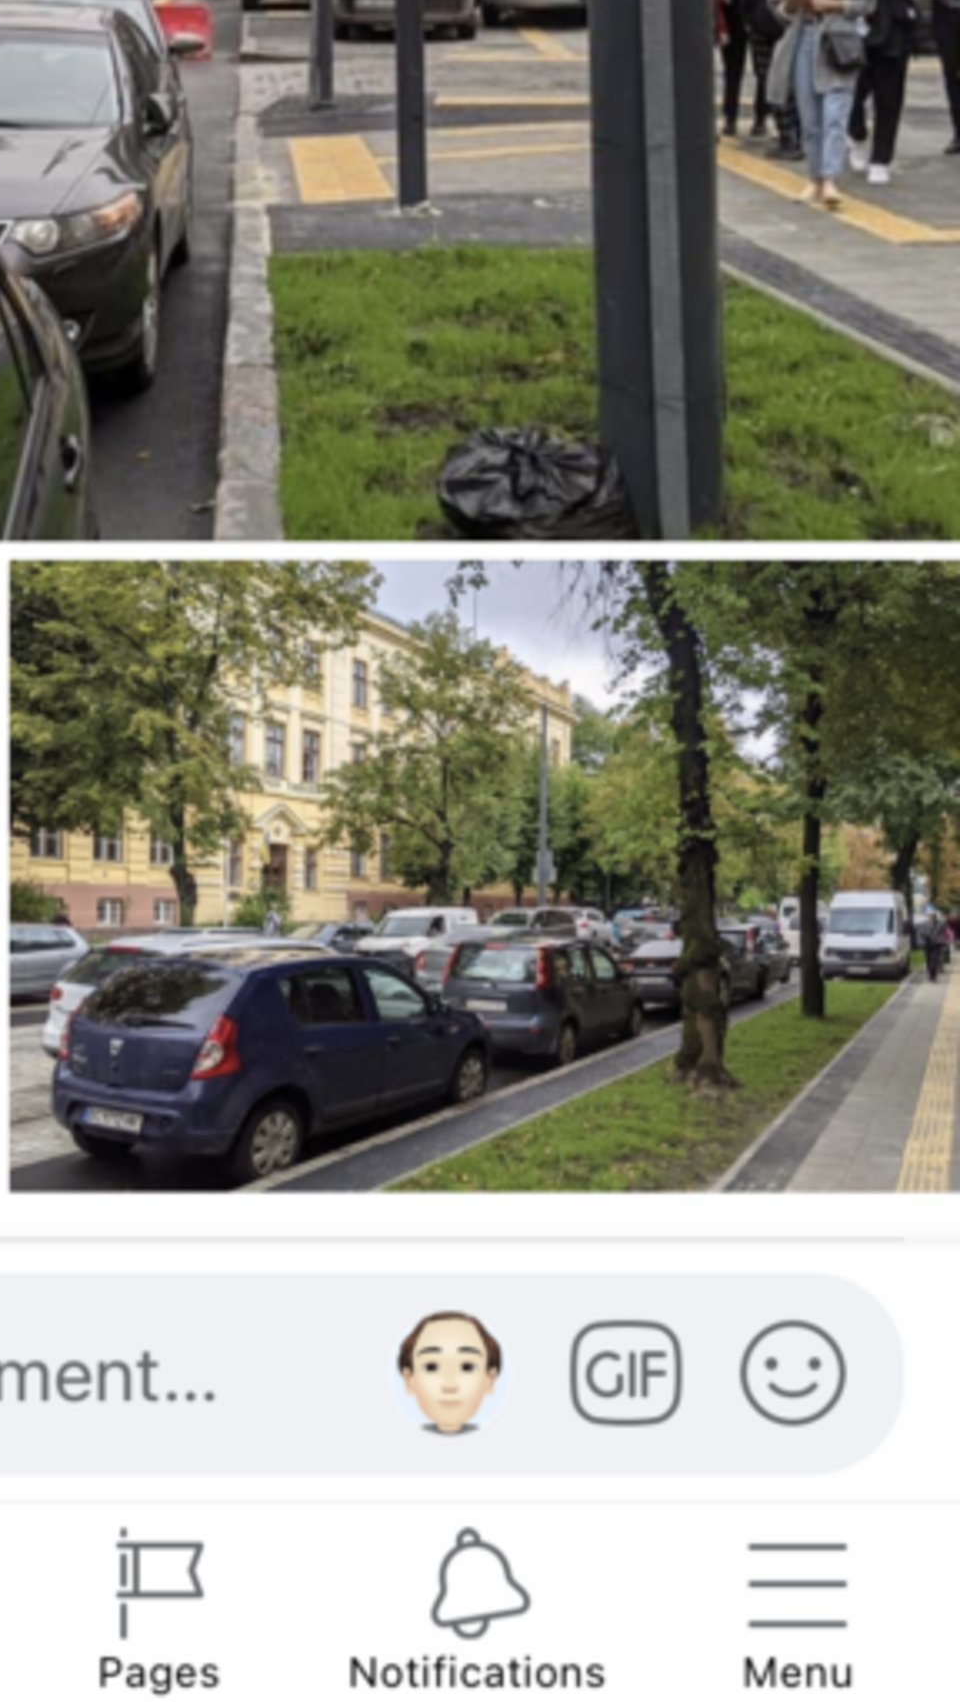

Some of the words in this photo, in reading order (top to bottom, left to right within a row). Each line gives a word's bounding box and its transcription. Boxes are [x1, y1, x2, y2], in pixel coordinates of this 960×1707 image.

[585, 1349, 668, 1400] GIF
[98, 1654, 221, 1697] Pages
[348, 1653, 607, 1690] Notifications
[742, 1655, 854, 1690] Menu
